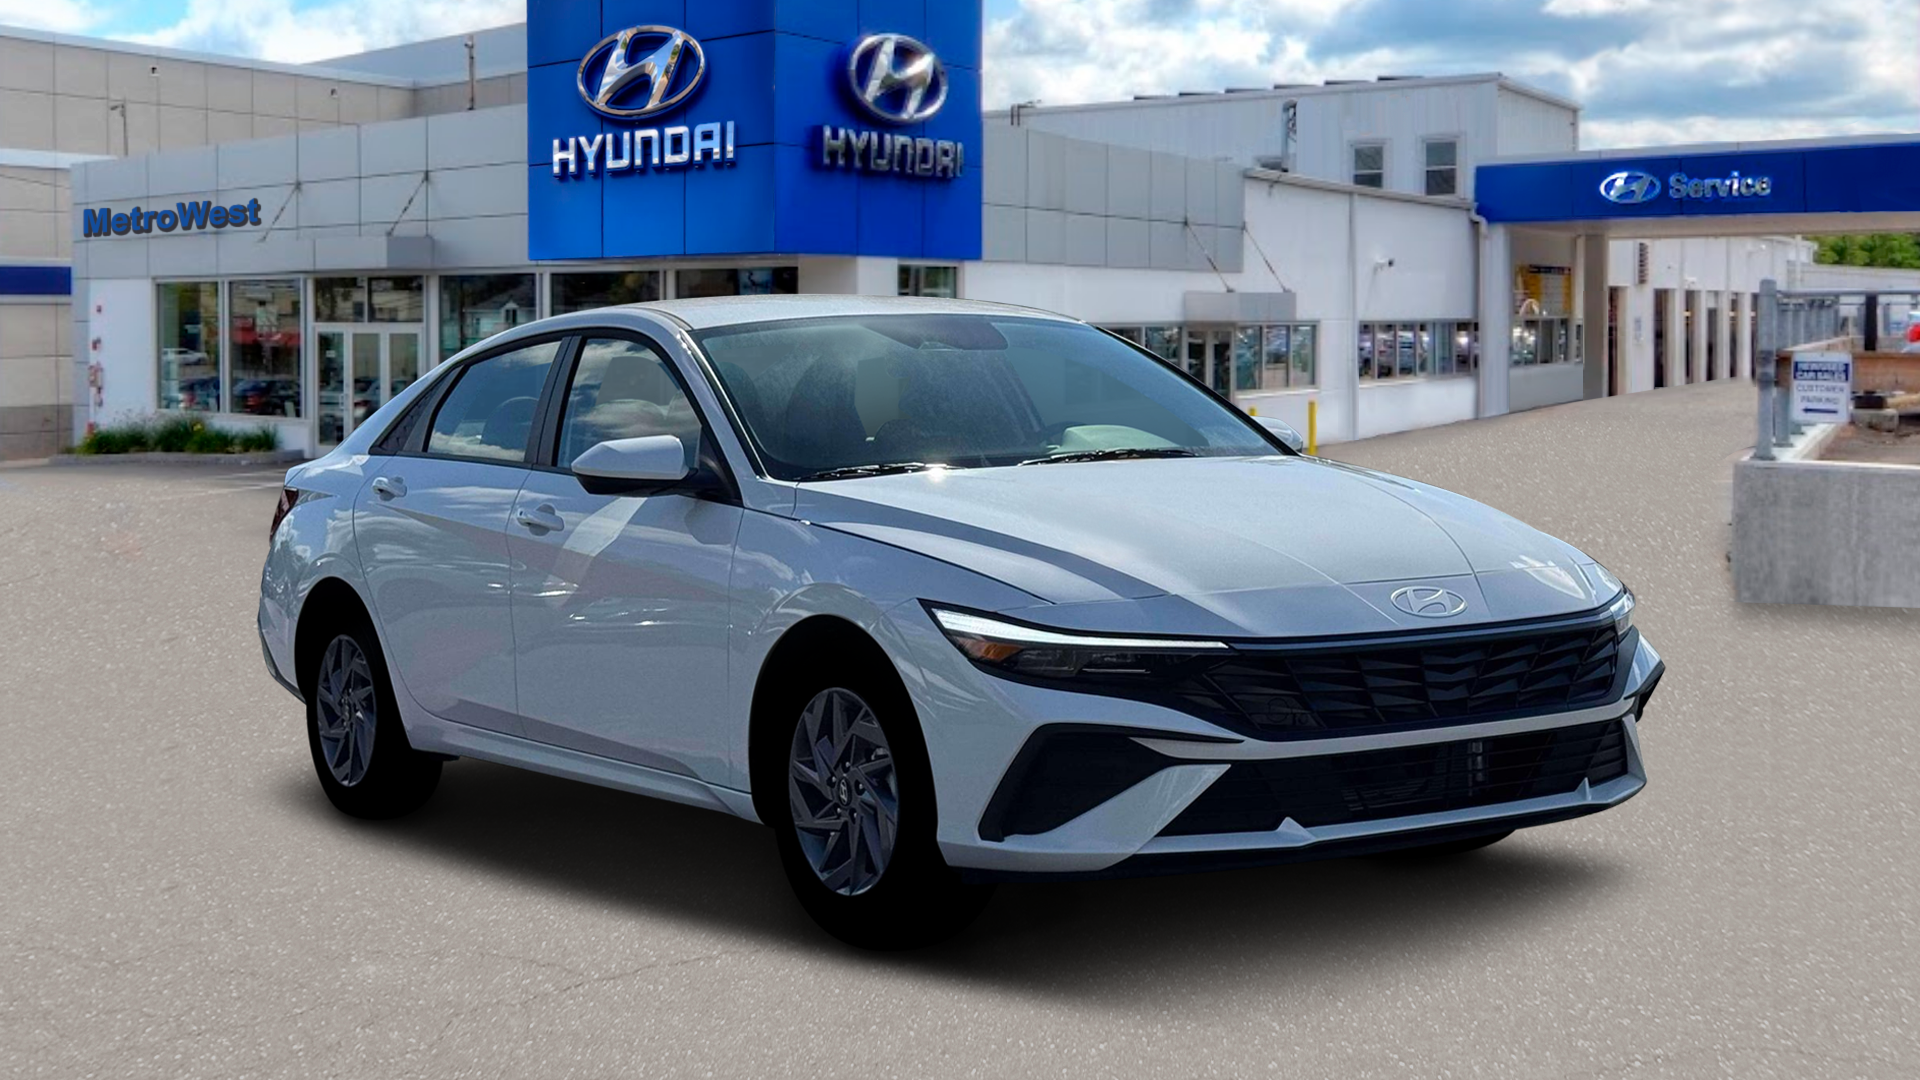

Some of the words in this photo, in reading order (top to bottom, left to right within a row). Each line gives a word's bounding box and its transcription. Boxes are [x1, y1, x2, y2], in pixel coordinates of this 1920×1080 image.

[552, 120, 736, 176] HYUNDAI
[822, 124, 964, 178] HYUNDAI
[1669, 171, 1772, 199] Service
[83, 198, 262, 237] MetroWest
[1796, 384, 1845, 393] CUSTOMER
[1800, 395, 1841, 405] PARKING
